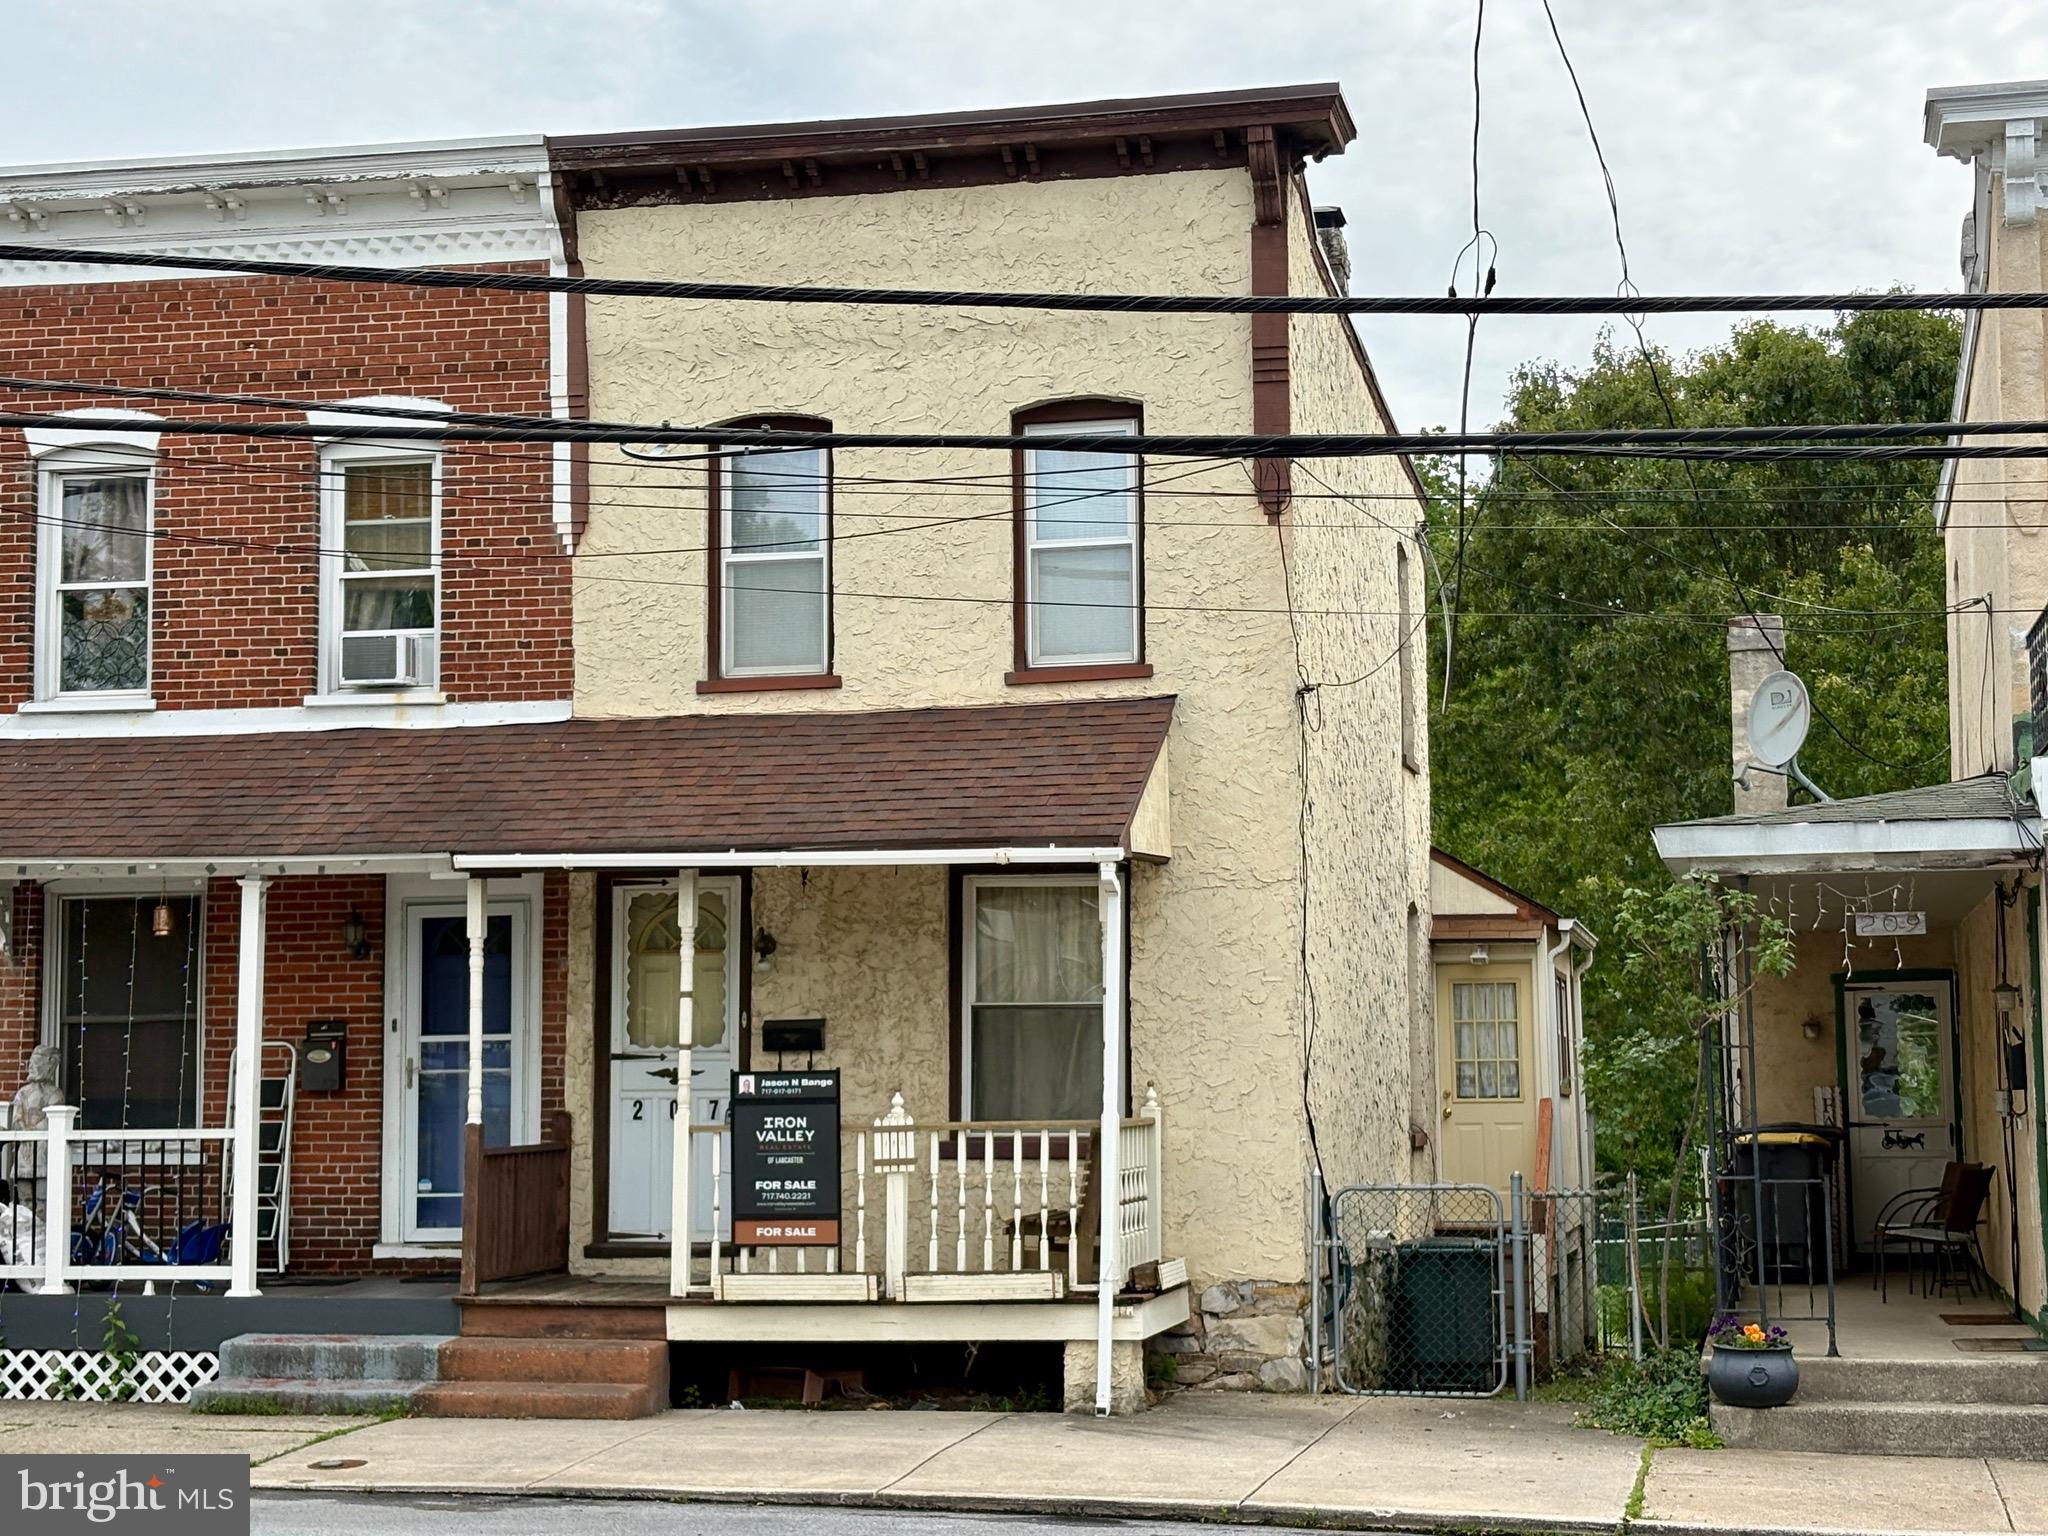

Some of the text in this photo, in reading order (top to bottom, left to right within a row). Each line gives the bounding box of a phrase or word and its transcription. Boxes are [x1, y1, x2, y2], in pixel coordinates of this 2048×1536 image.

[761, 1079, 789, 1087] Jason
[763, 1116, 807, 1129] IRON
[756, 1130, 815, 1142] VALLEY
[755, 1180, 816, 1190] FOR SALE
[756, 1227, 817, 1237] FOR SALE
